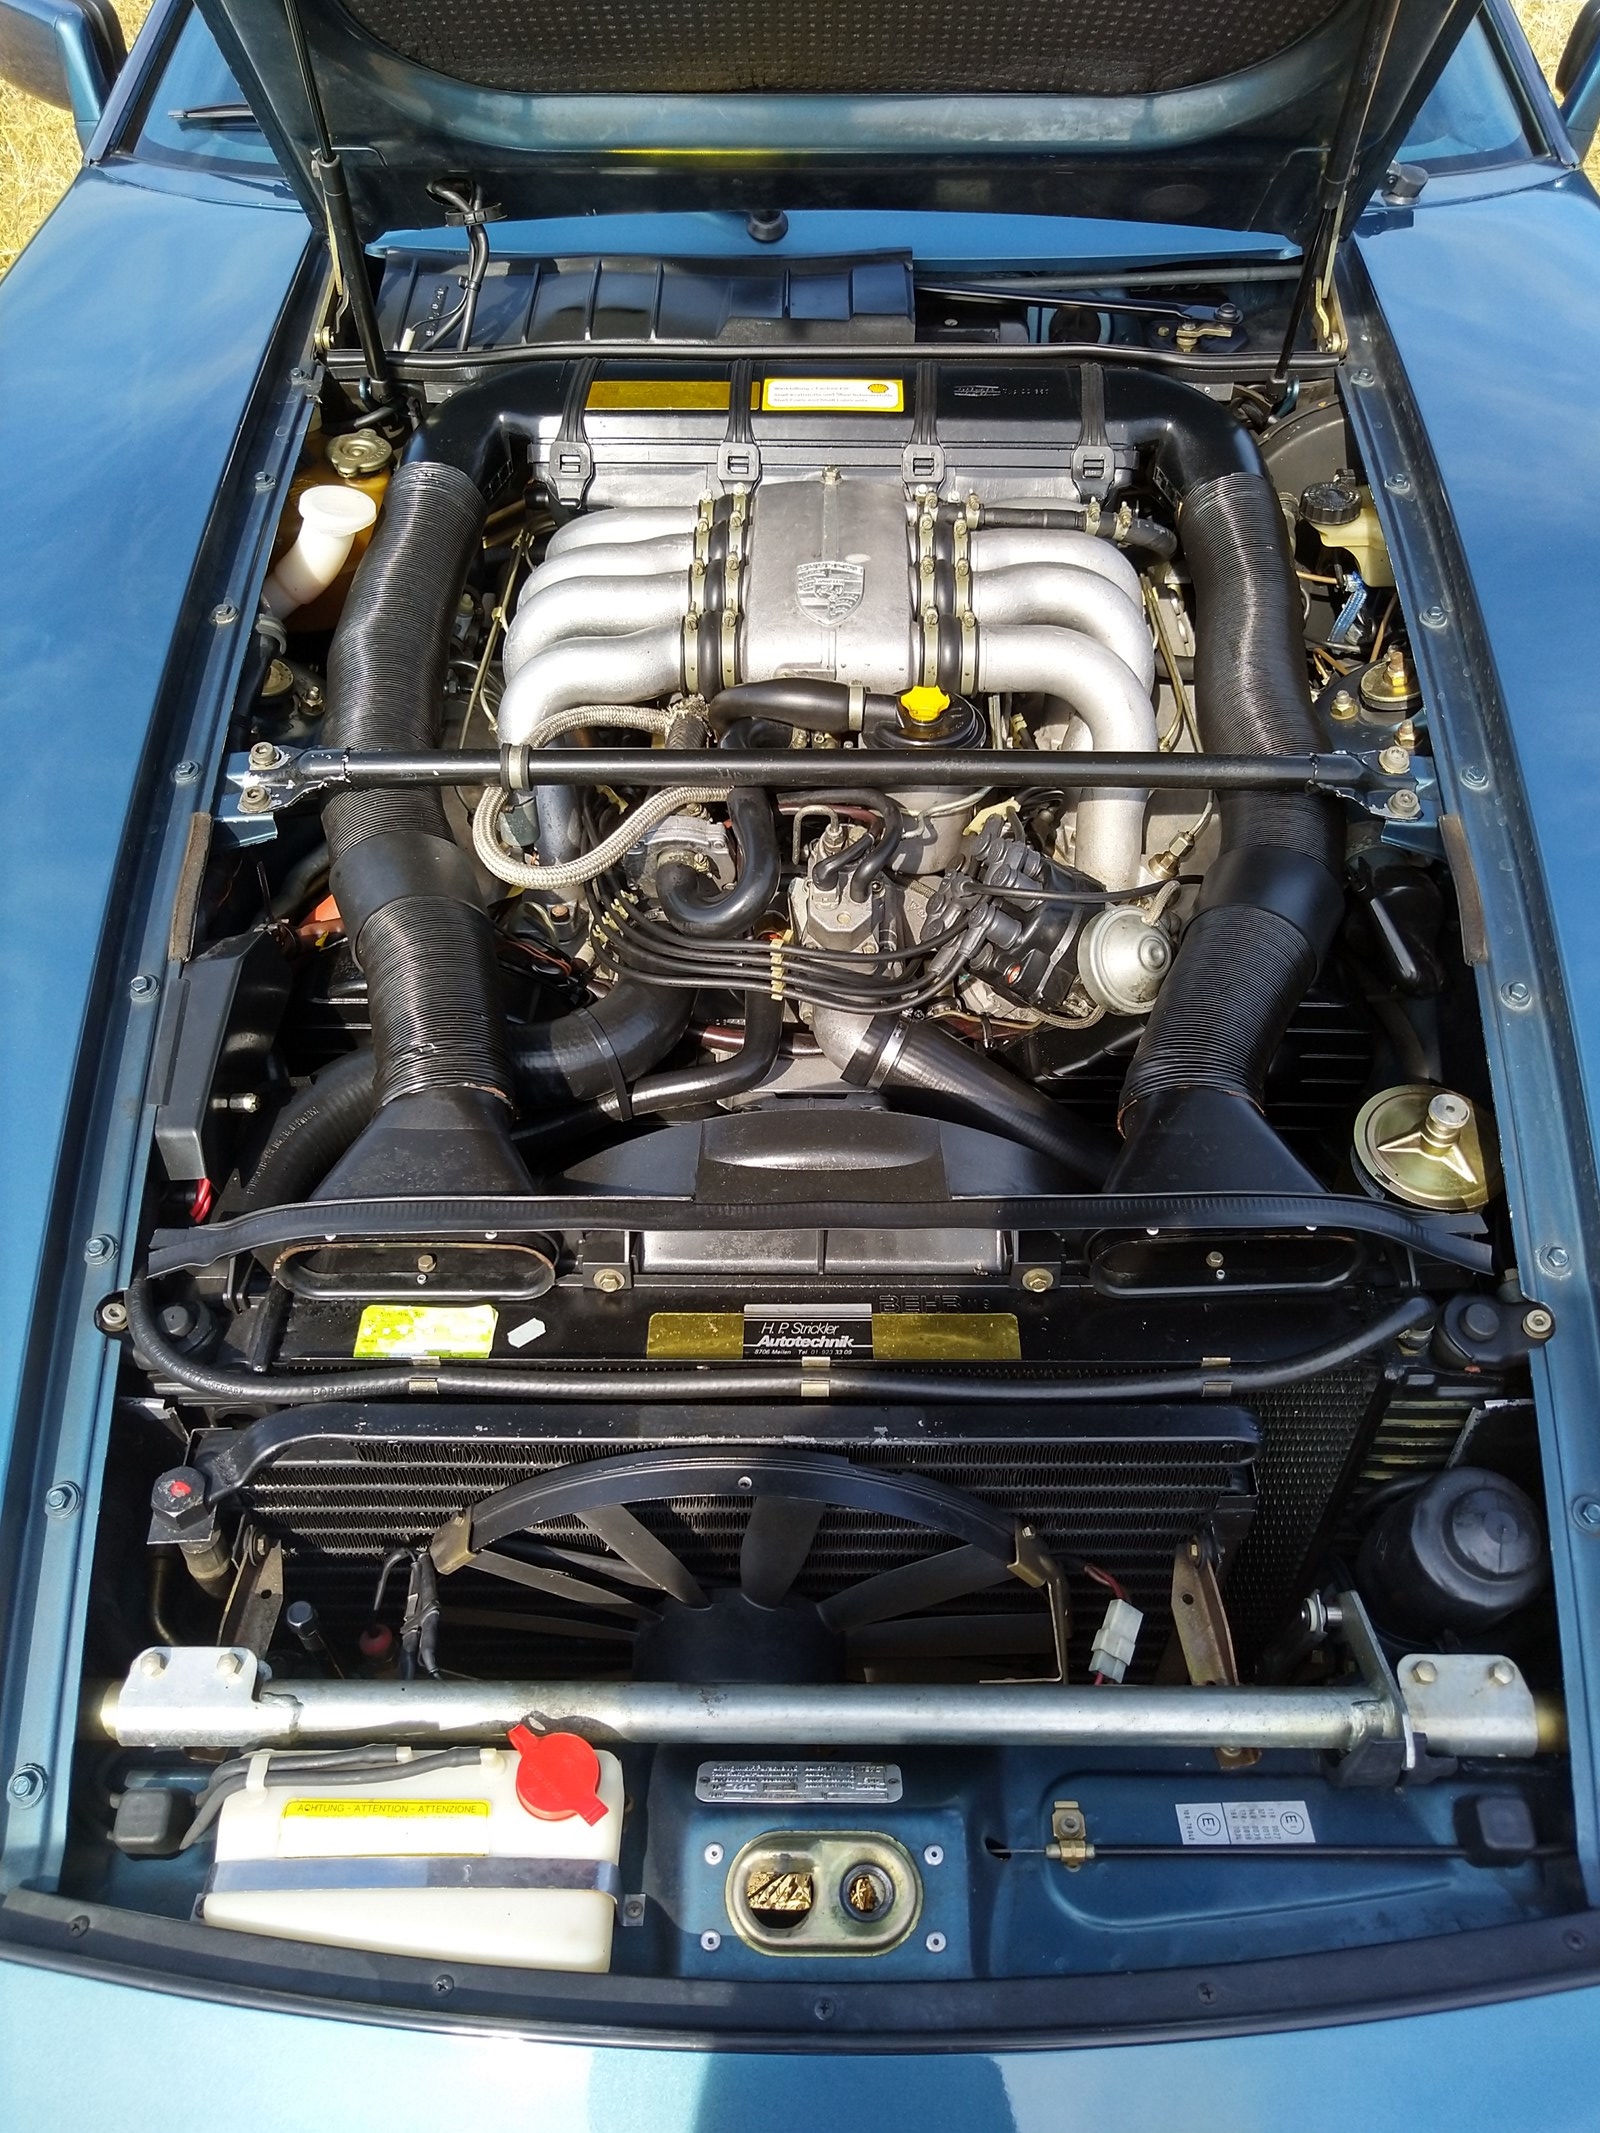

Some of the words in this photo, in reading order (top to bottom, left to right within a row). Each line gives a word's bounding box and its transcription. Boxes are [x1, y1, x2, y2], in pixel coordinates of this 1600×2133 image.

[878, 1295, 962, 1314] BEHR
[791, 1322, 840, 1335] Strickler
[757, 1334, 855, 1348] Autotechnik
[311, 1384, 368, 1399] PORSCHE
[297, 1803, 345, 1813] ACHTUNG
[354, 1803, 409, 1813] ATTENTION
[417, 1804, 477, 1814] ATTENZIONE
